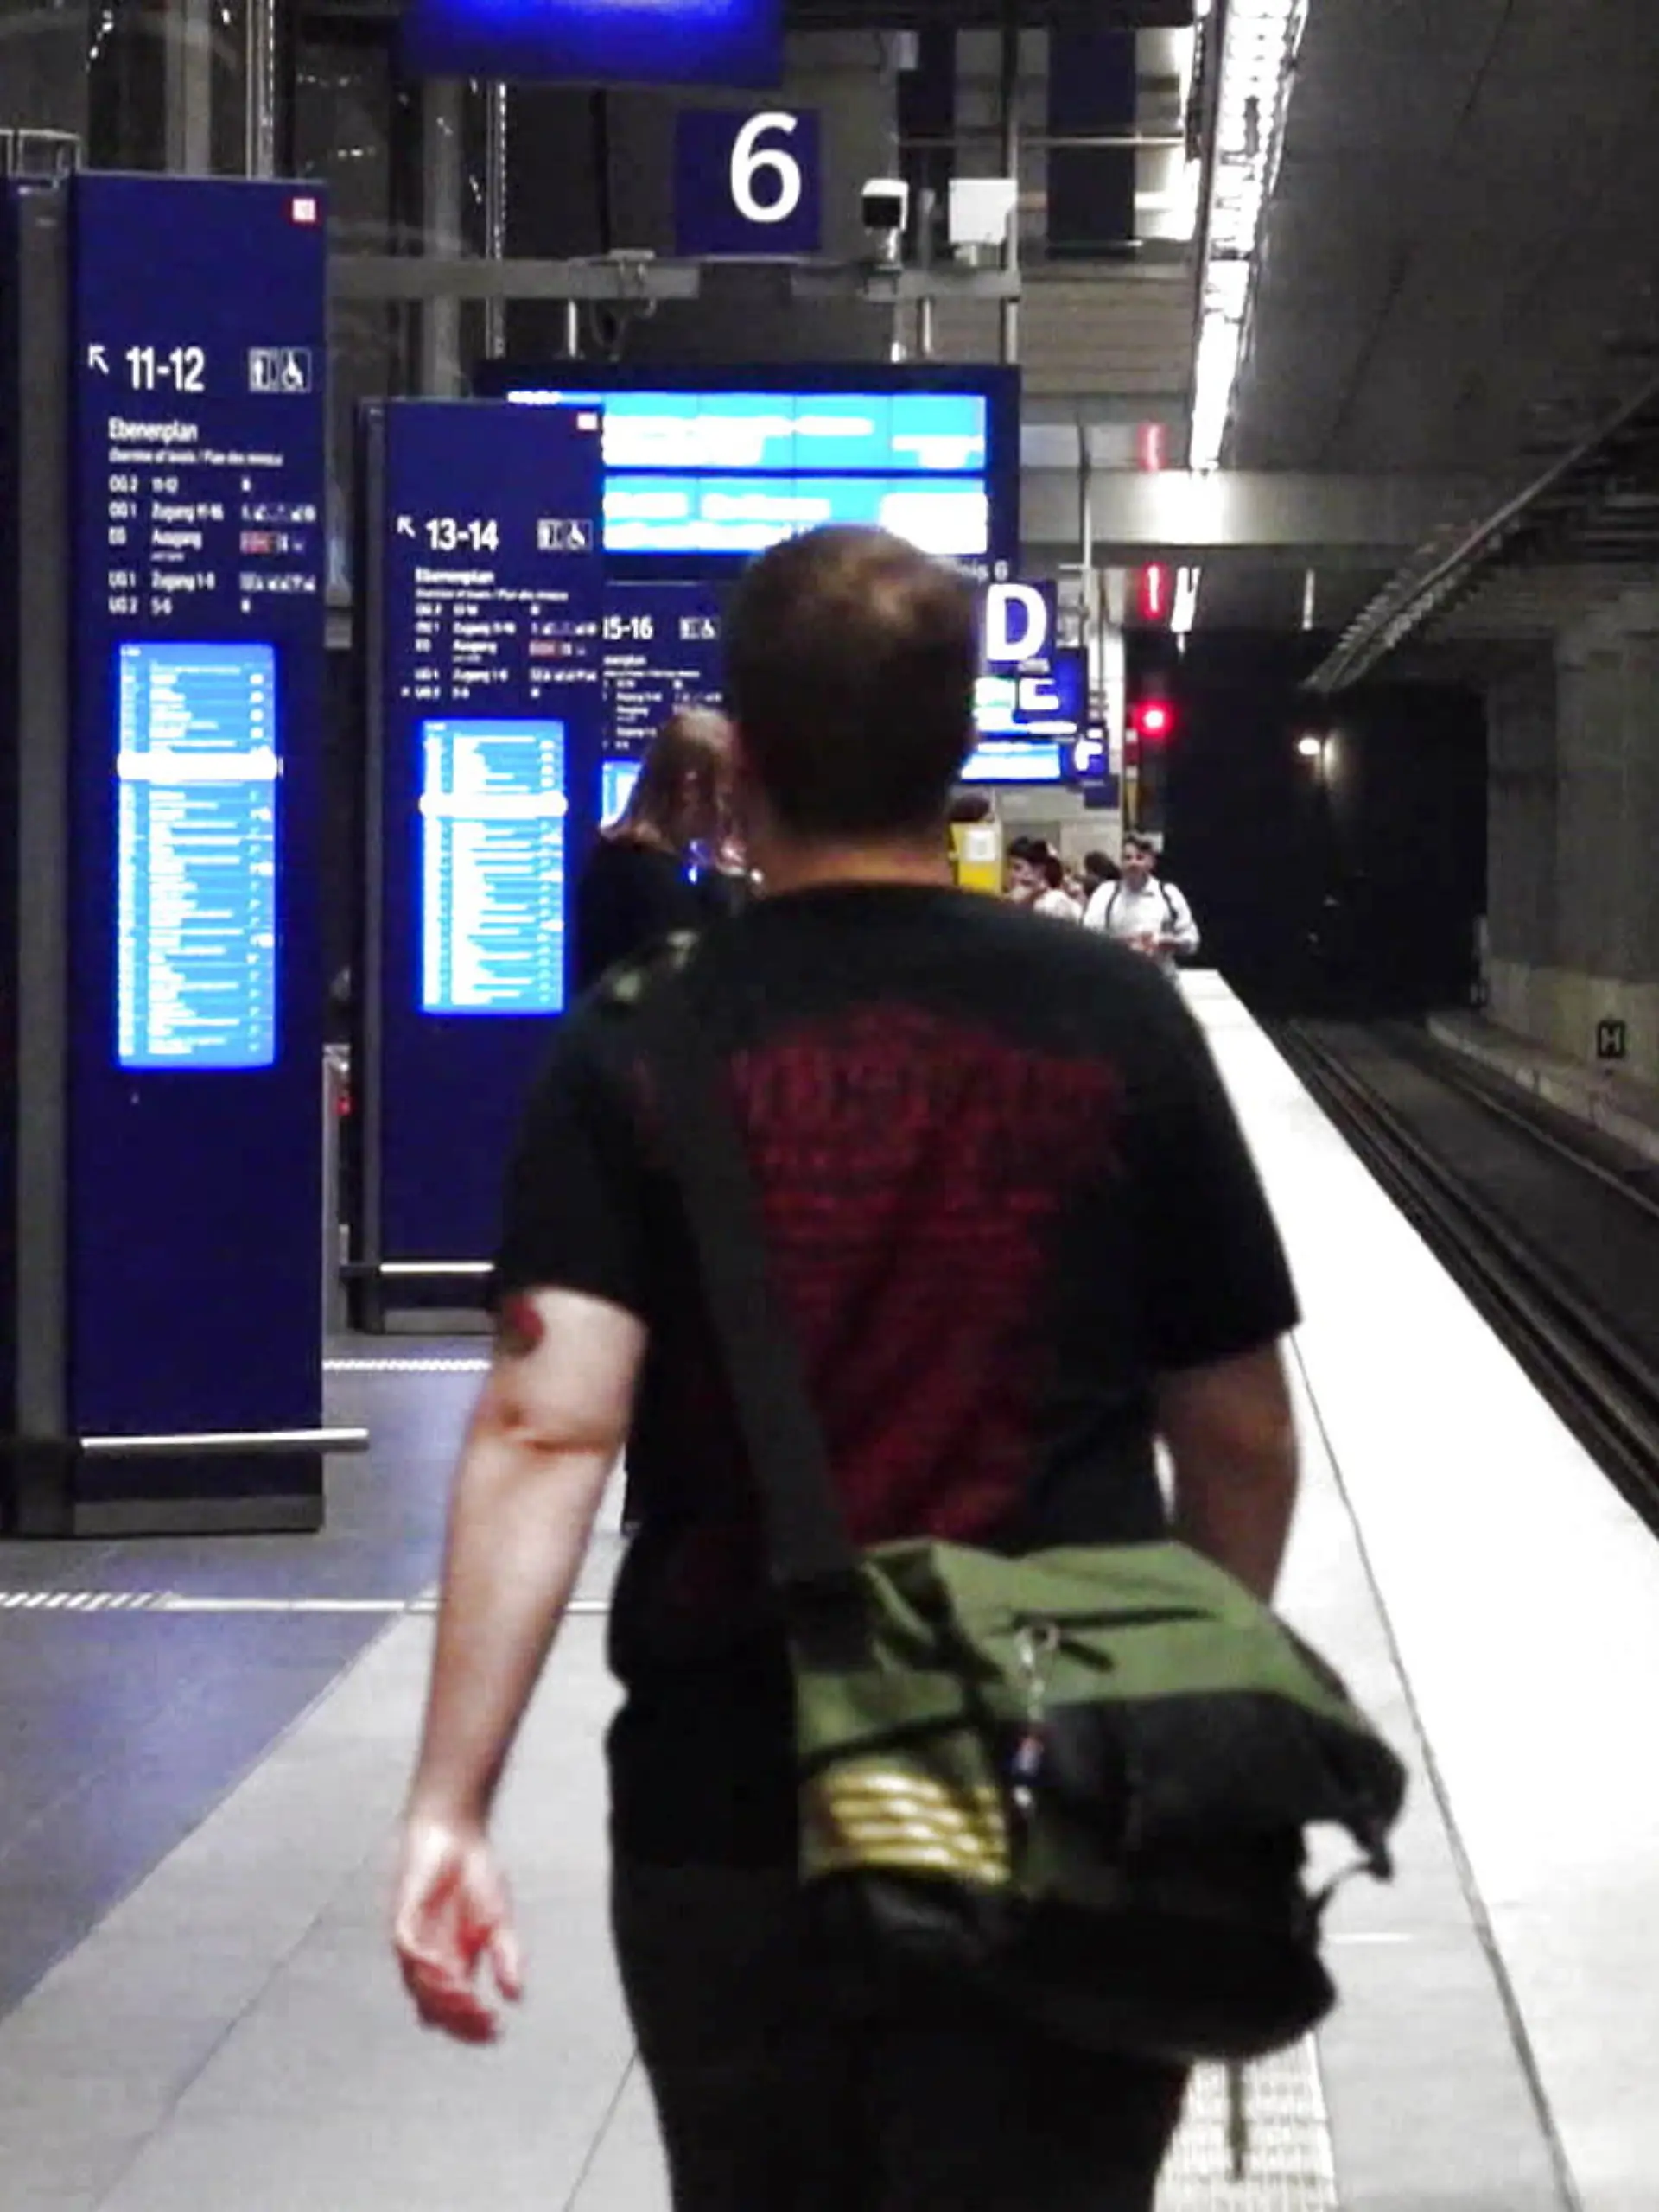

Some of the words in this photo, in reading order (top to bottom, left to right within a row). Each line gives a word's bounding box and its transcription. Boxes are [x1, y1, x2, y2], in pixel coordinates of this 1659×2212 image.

[730, 111, 801, 223] 6
[125, 346, 205, 391] 11-12
[426, 518, 499, 551] 13-14
[987, 583, 1046, 660] D
